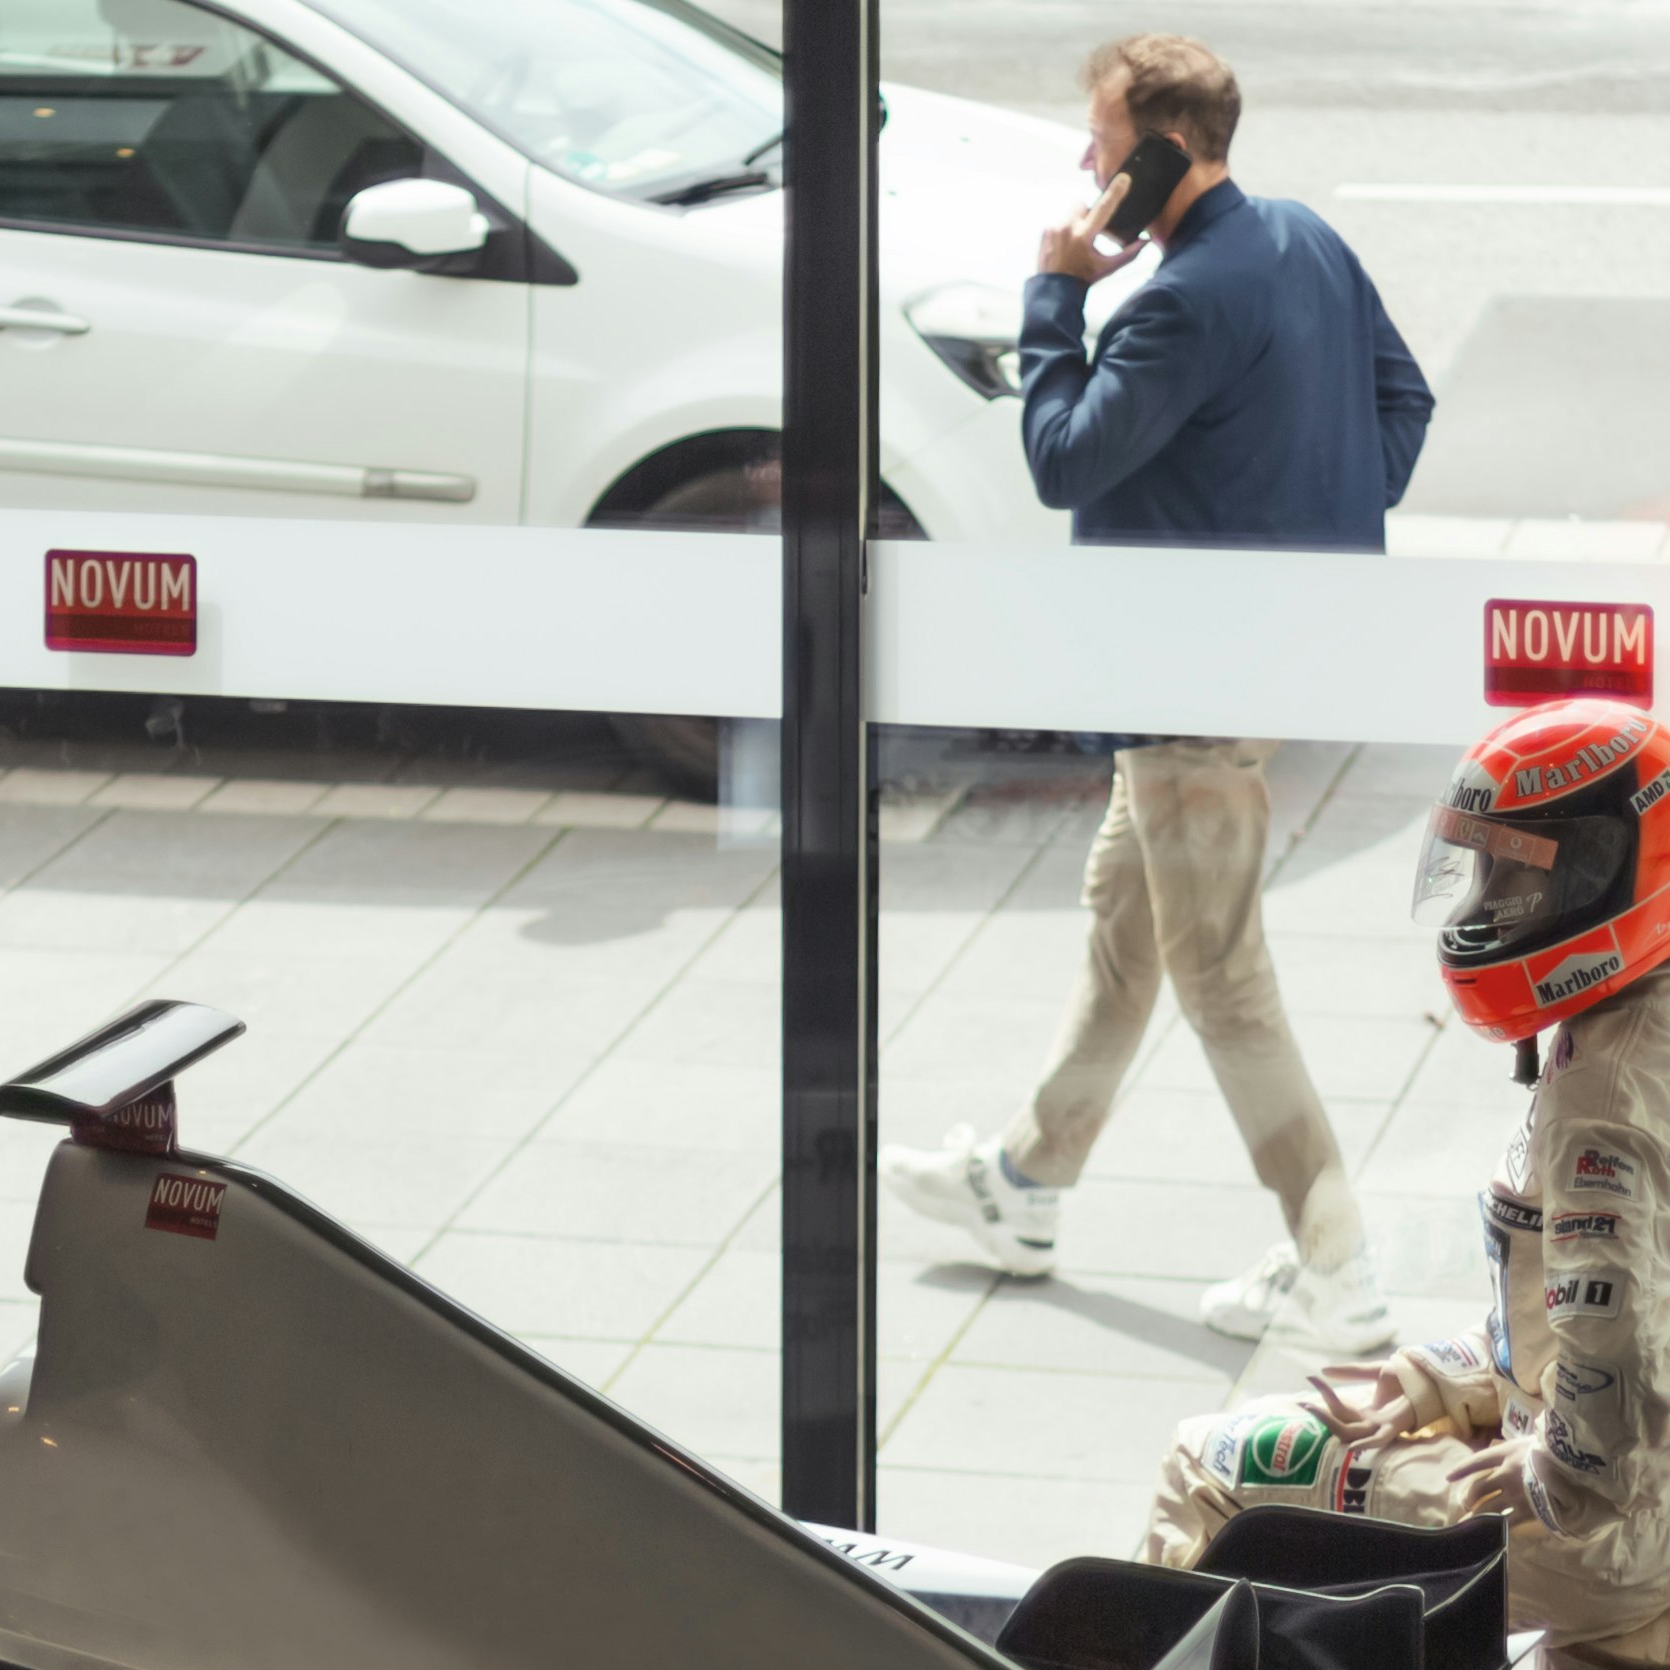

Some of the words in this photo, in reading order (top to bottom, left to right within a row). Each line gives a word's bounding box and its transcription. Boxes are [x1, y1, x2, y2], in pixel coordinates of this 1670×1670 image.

[51, 558, 191, 611] NOVUM
[1492, 609, 1646, 665] NOVUM
[1514, 718, 1647, 798] Marlboro
[1633, 781, 1666, 814] AMD
[1535, 954, 1621, 1006] Marlboro
[1576, 1156, 1616, 1178] Roth
[153, 1177, 225, 1215] NOVUM
[1544, 1279, 1579, 1310] obil
